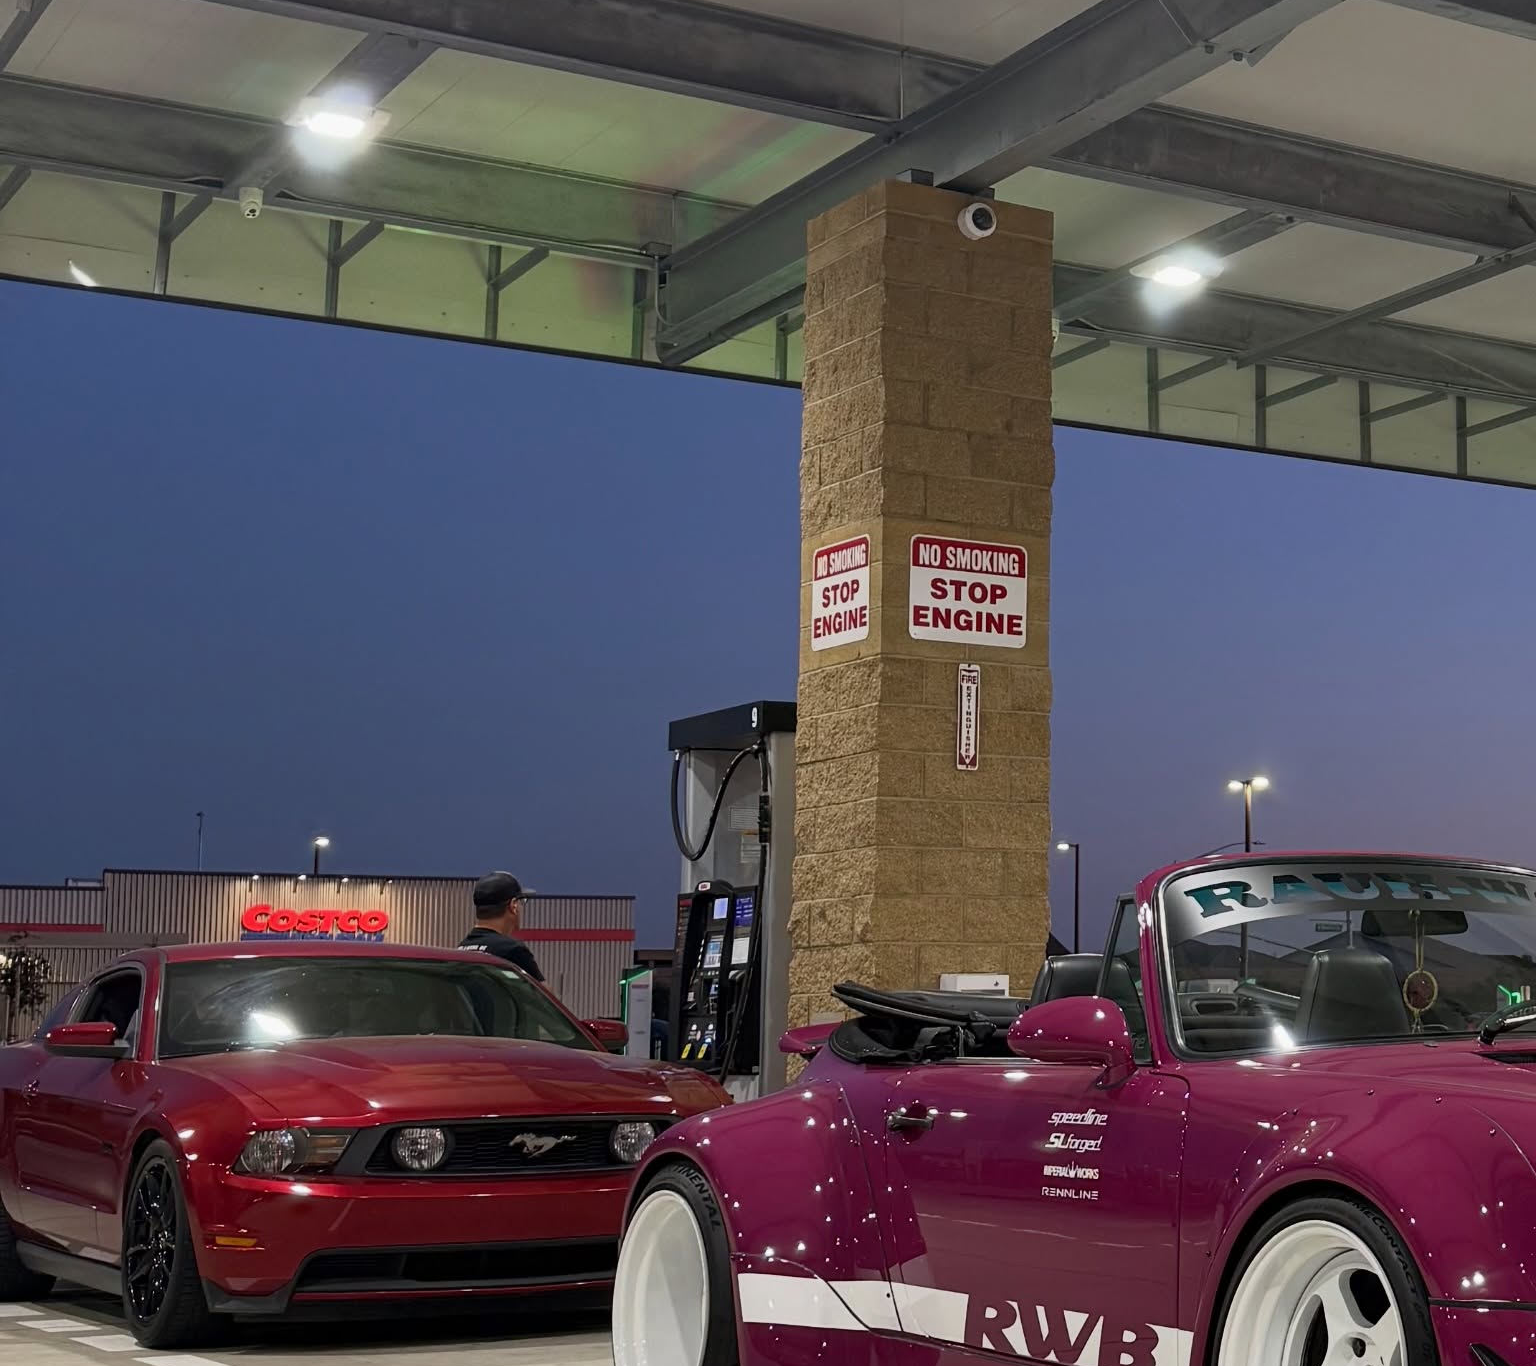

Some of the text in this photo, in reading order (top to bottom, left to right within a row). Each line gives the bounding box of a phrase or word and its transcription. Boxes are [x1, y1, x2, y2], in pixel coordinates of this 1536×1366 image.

[816, 543, 866, 578] NO SMOKING
[919, 543, 1020, 575] NO SMOKING
[822, 579, 860, 609] STOP
[930, 577, 1008, 605] STOP
[813, 605, 868, 639] ENGINE
[913, 604, 1024, 636] ENGINE
[961, 674, 978, 685] FIRE
[751, 706, 759, 728] 9
[242, 904, 389, 933] COSTCO
[1047, 1108, 1109, 1127] speedline
[1041, 1187, 1099, 1200] RENNLINE
